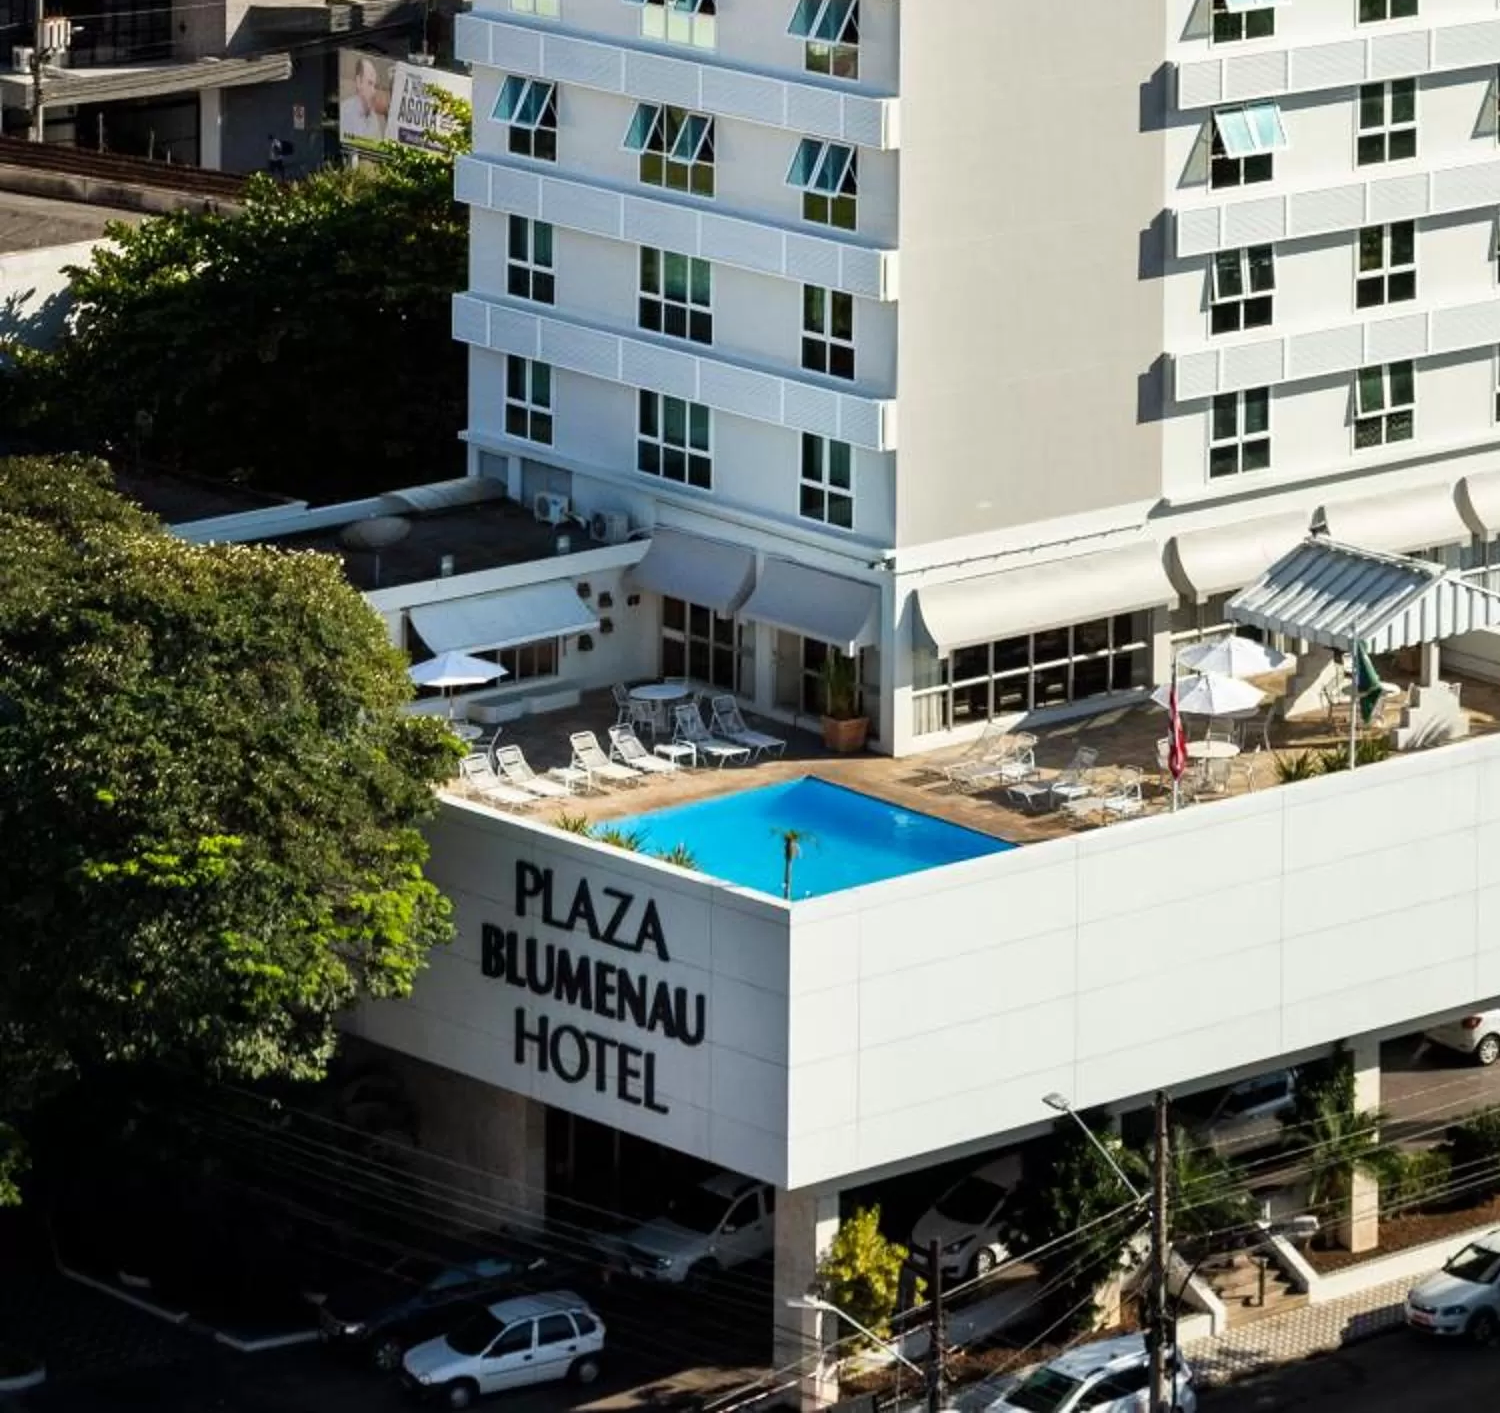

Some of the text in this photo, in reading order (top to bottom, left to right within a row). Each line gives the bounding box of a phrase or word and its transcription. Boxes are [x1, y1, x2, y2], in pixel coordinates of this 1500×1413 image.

[397, 95, 437, 130] AGORA
[515, 858, 670, 963] PLAZA
[481, 922, 706, 1047] BLUMENAU
[514, 1006, 670, 1116] HOTEL
